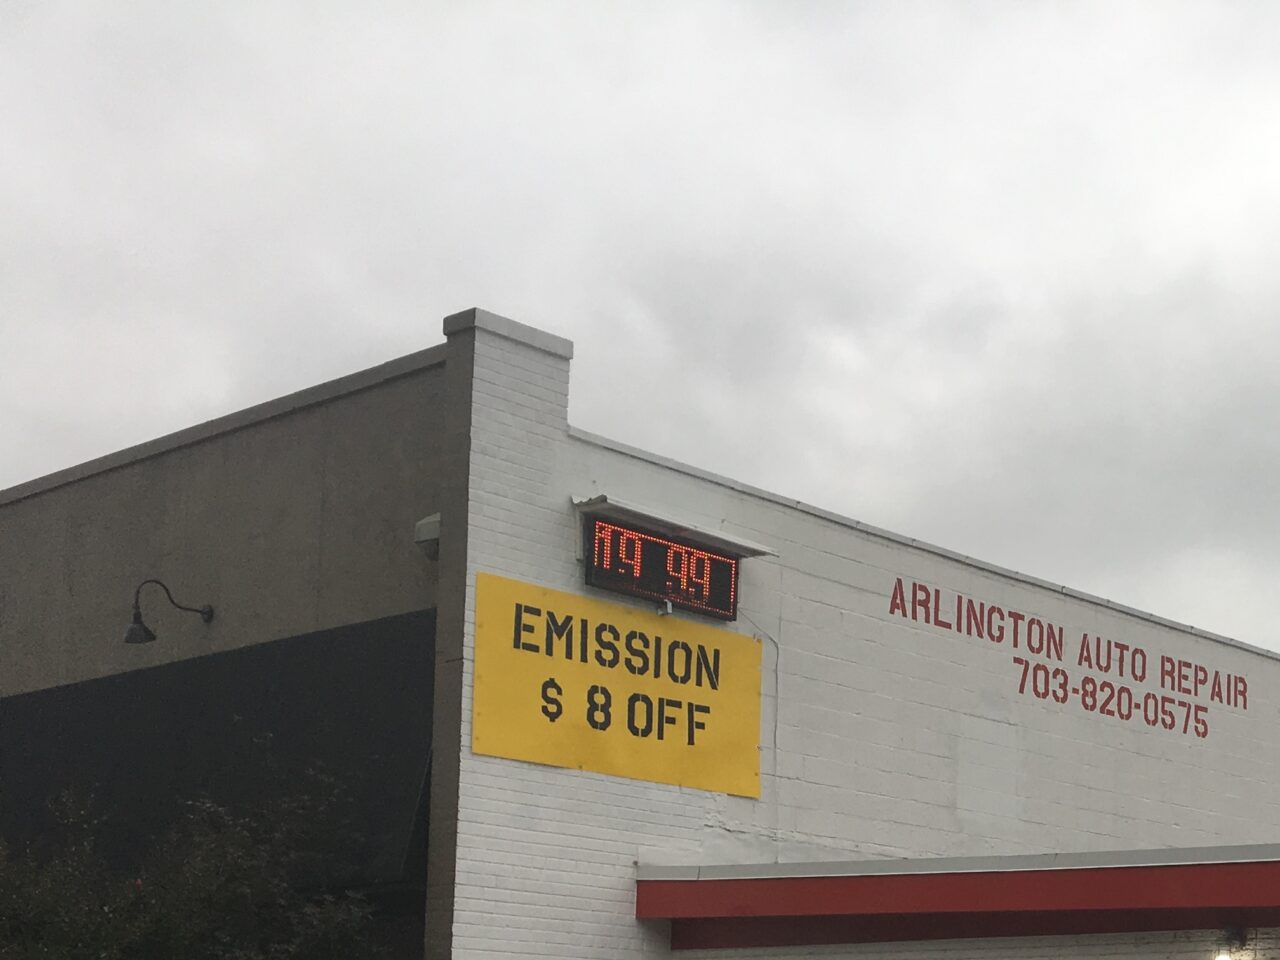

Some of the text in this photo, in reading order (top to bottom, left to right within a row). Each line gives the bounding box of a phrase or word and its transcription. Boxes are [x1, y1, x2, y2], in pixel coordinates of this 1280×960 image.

[513, 603, 720, 691] EMISSION
[889, 578, 1248, 710] ARLINGTON AUTO REPAIR
[627, 692, 710, 746] OFF
[1013, 656, 1209, 738] 703-820-0575
